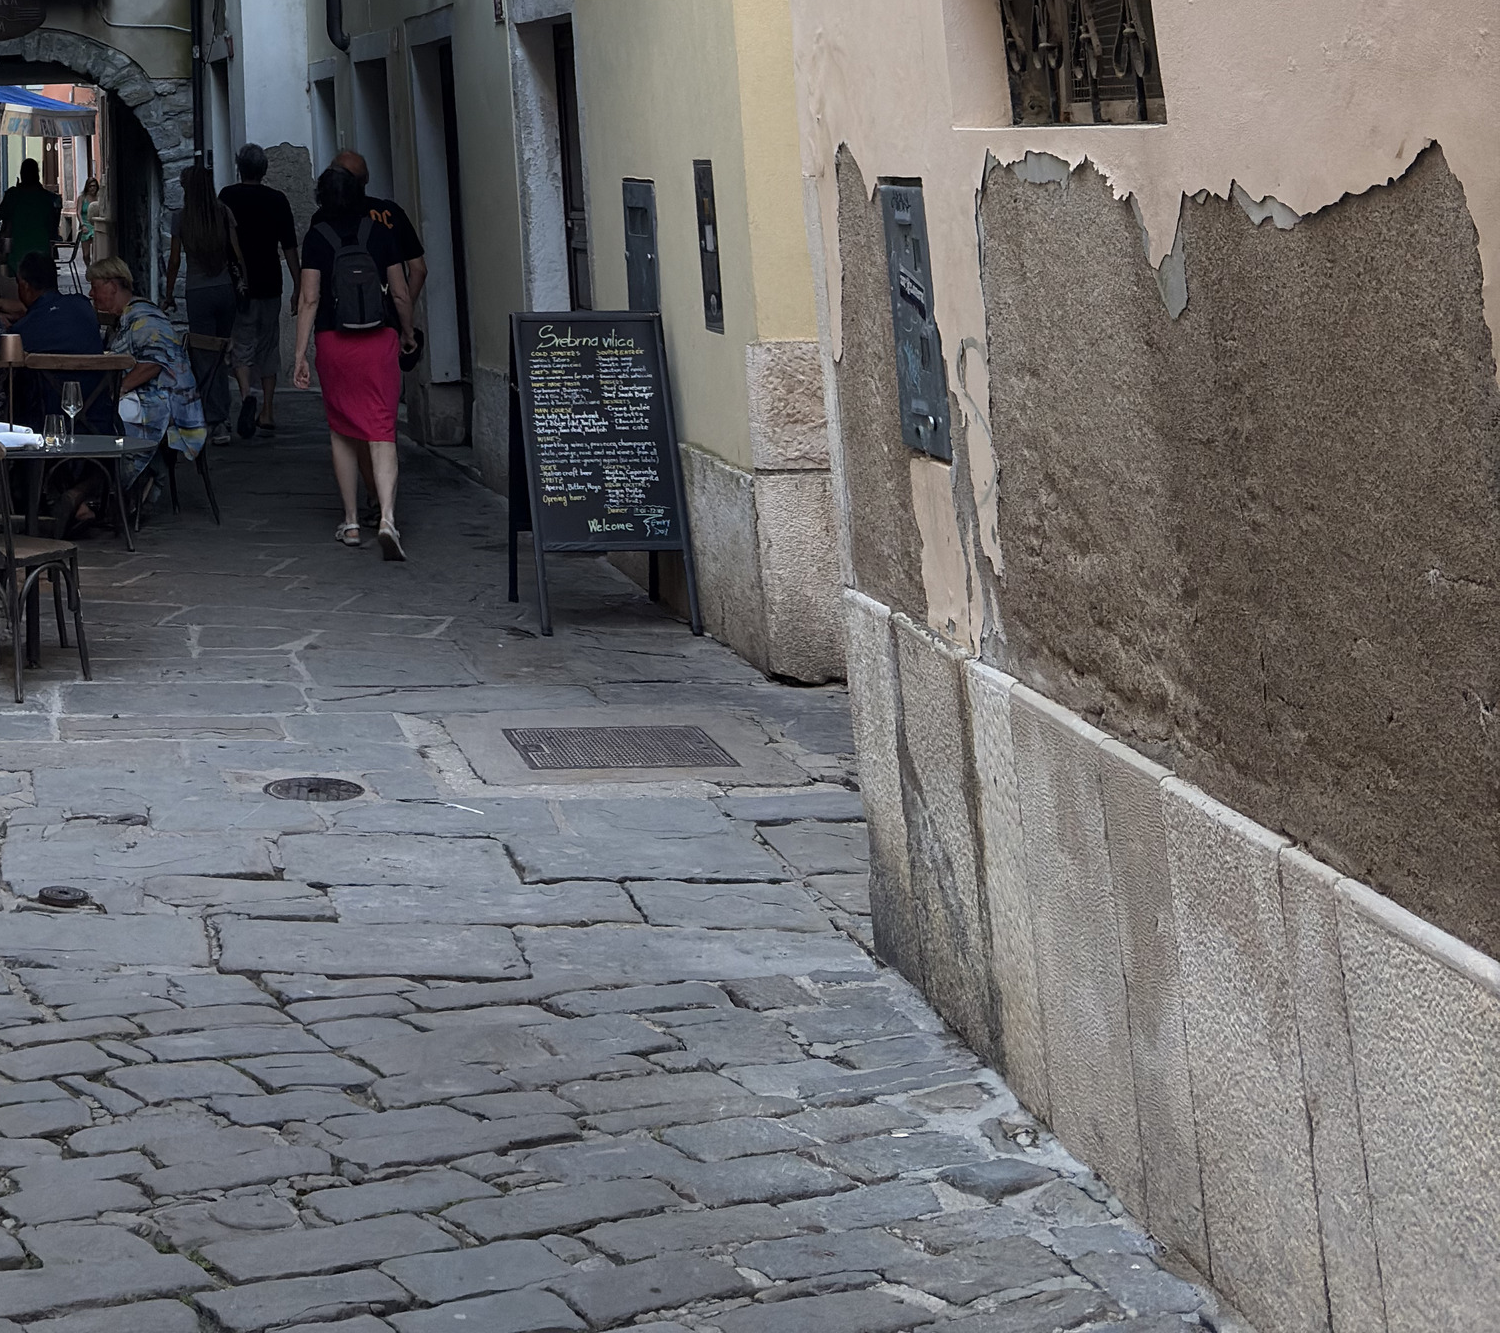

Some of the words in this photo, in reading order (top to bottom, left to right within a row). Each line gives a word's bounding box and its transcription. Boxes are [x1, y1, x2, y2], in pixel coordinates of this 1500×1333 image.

[537, 325, 598, 349] Srebrna
[602, 329, 634, 348] vilica
[569, 493, 587, 501] hours
[588, 519, 634, 533] Welcome
